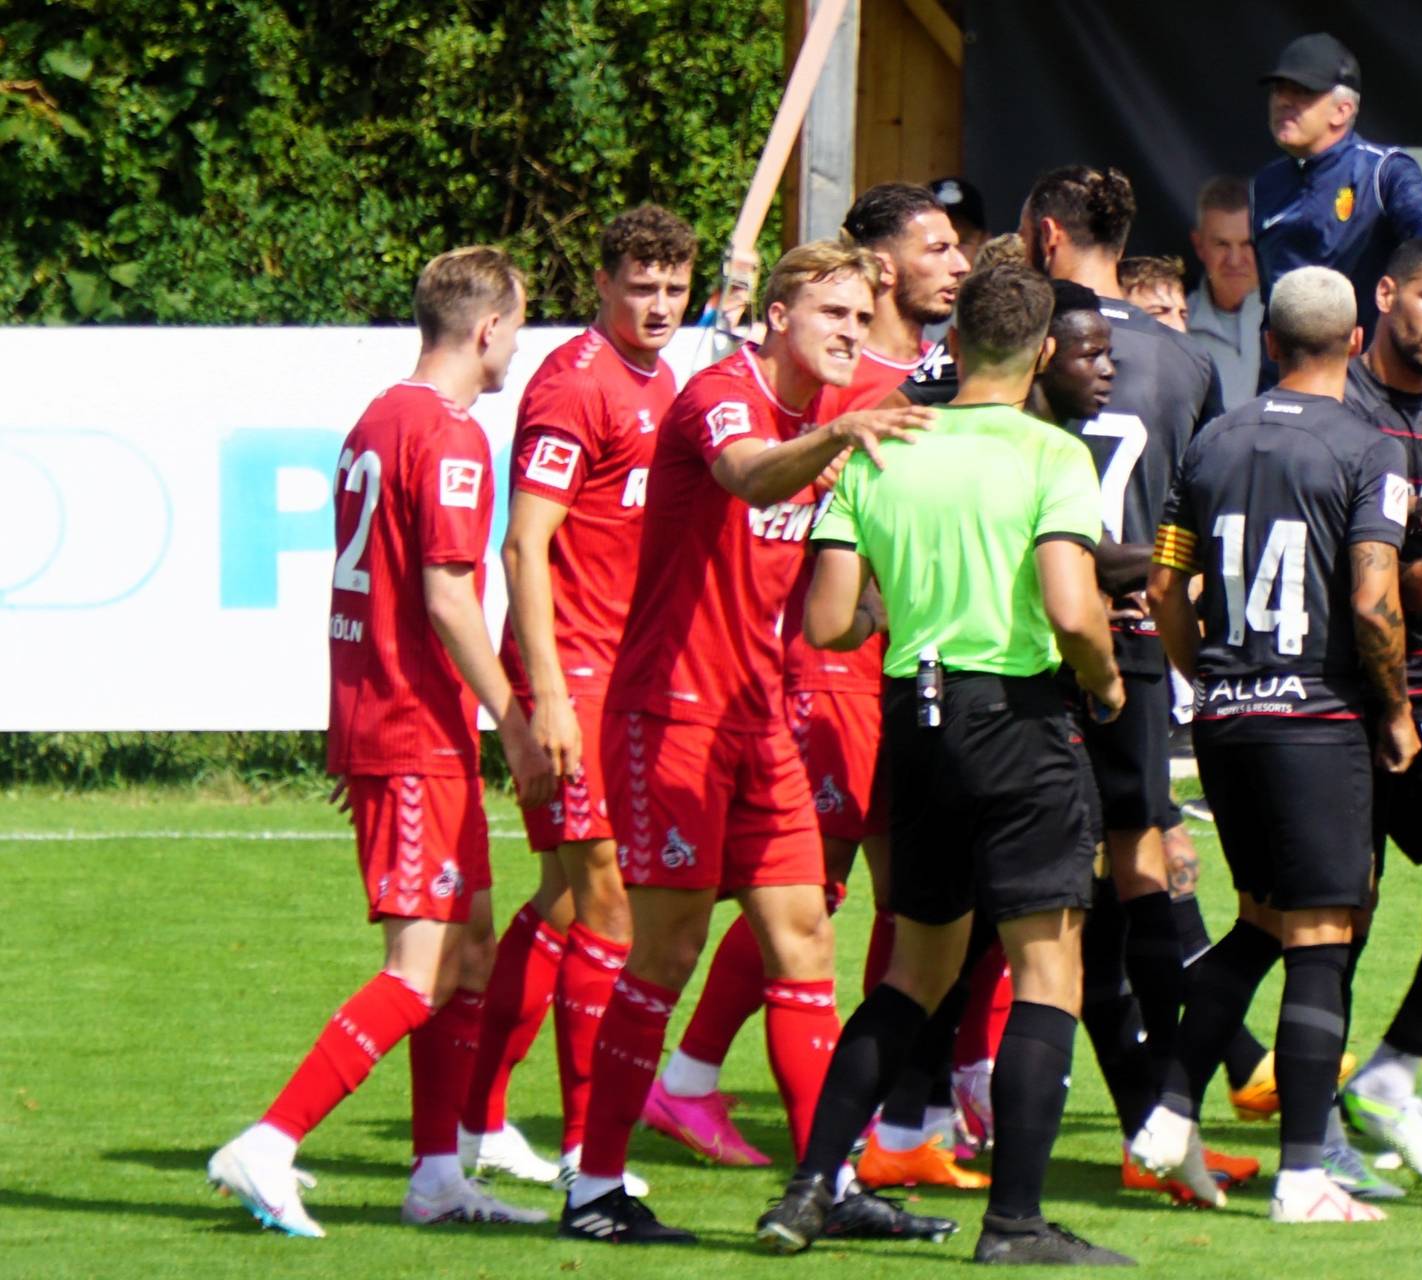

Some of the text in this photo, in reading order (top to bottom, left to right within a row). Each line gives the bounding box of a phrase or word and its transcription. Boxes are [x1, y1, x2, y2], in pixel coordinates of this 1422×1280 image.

[1082, 412, 1148, 545] 7
[1212, 514, 1309, 656] 14
[1209, 676, 1308, 702] ALUA
